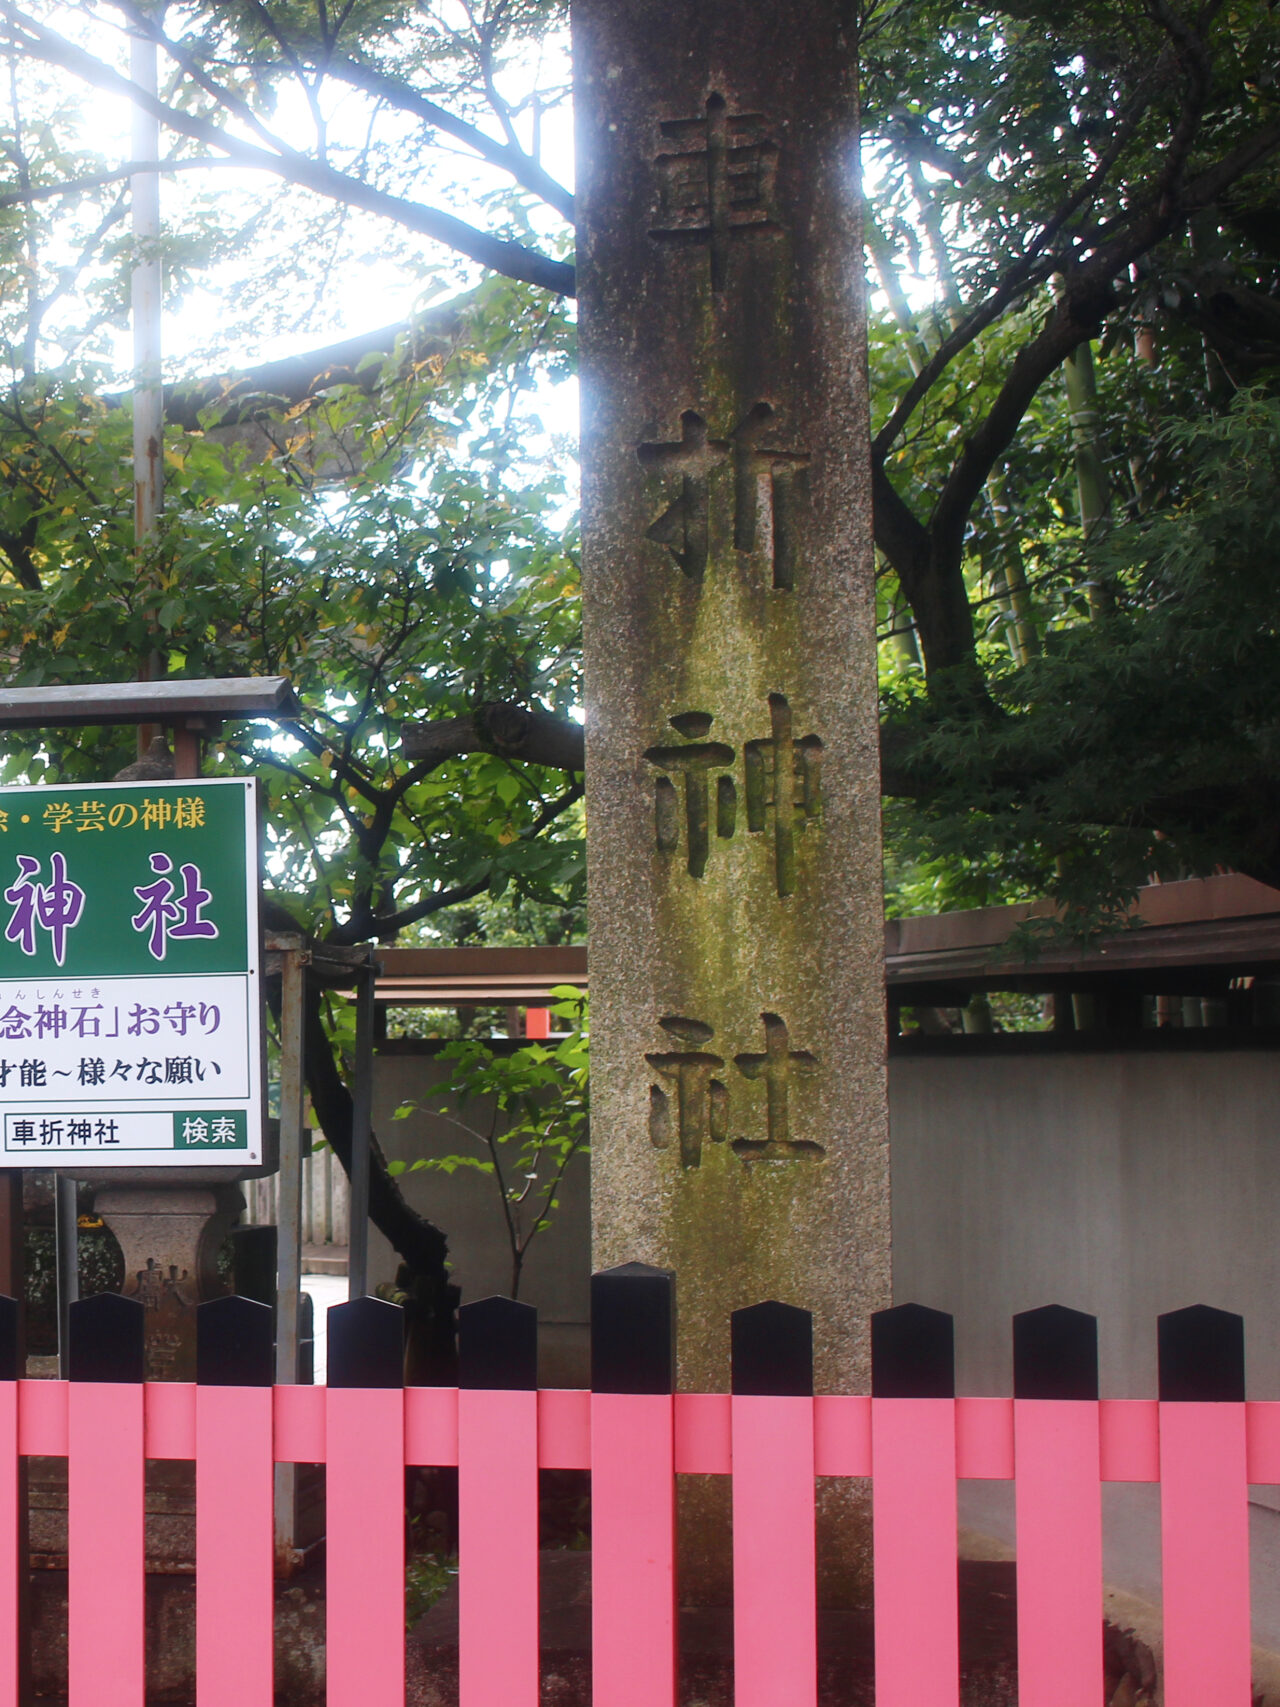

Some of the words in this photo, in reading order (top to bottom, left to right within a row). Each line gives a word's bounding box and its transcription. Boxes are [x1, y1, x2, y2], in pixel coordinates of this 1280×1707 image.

[637, 92, 826, 1169] 車折神社
[12, 1119, 120, 1146] 車折神社
[182, 1116, 237, 1145] 検索
